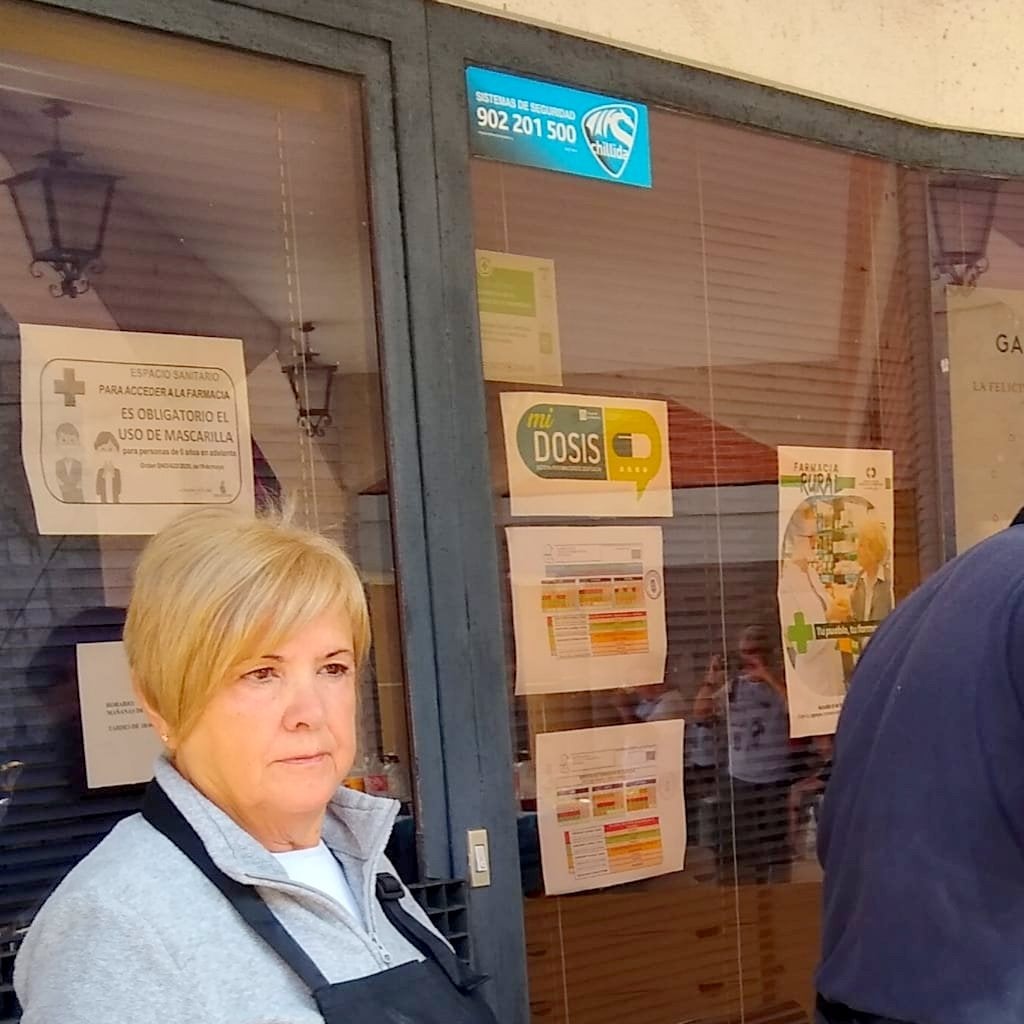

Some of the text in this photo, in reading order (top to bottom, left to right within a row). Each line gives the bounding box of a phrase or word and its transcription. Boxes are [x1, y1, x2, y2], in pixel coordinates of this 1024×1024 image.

[518, 100, 528, 110] DE
[476, 107, 509, 130] 902
[513, 115, 542, 137] 201
[547, 121, 577, 143] 500
[591, 141, 629, 160] chillida
[130, 368, 220, 382] ESPACIO SANITARIO
[99, 384, 230, 400] PARA ACCEDER A LA FARMACIA
[121, 407, 229, 423] ES OBLIGATORIO EL
[527, 408, 554, 428] mi
[118, 428, 234, 443] USO DE MASCARILLA
[533, 430, 601, 464] DOSIS
